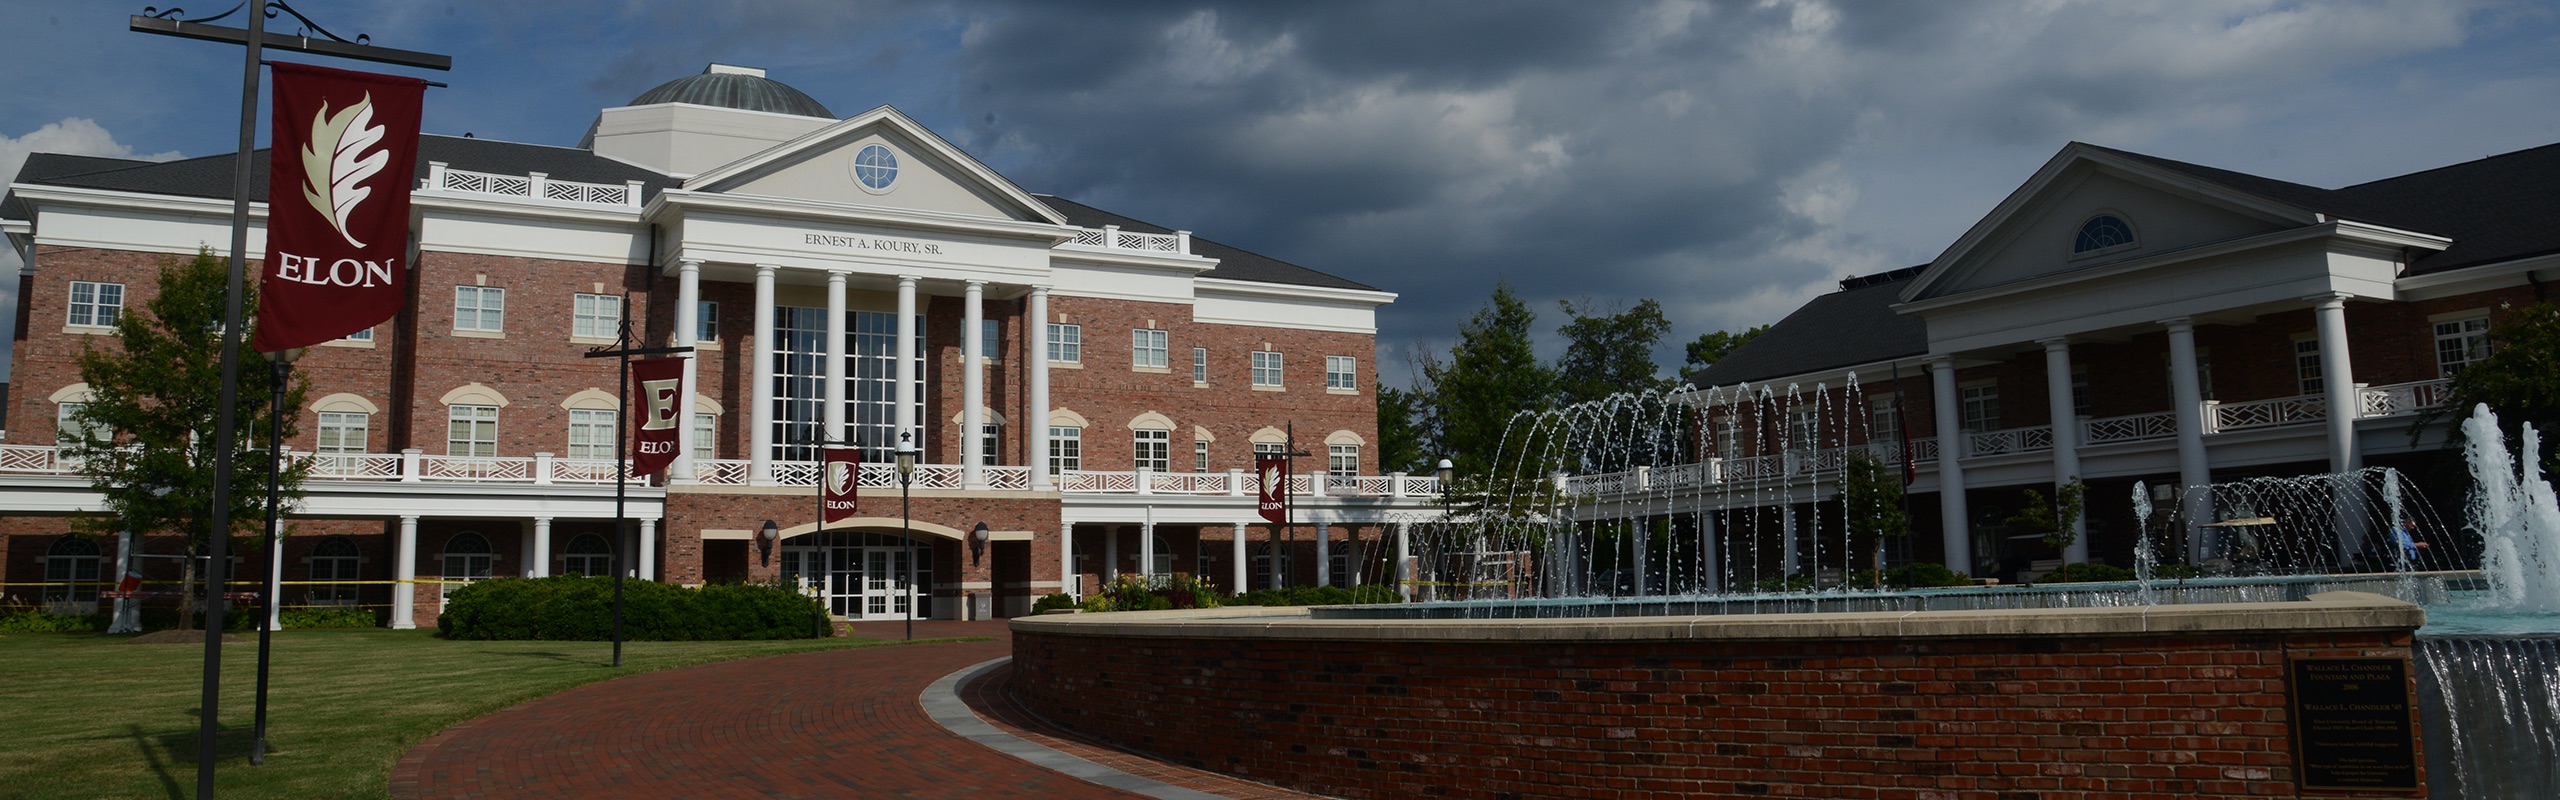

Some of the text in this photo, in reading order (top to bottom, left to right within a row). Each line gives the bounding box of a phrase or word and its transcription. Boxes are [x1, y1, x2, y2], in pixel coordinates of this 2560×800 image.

[805, 234, 943, 255] ERNEST A. KOURY, SR.
[276, 251, 394, 287] ELON
[827, 500, 855, 510] ELON
